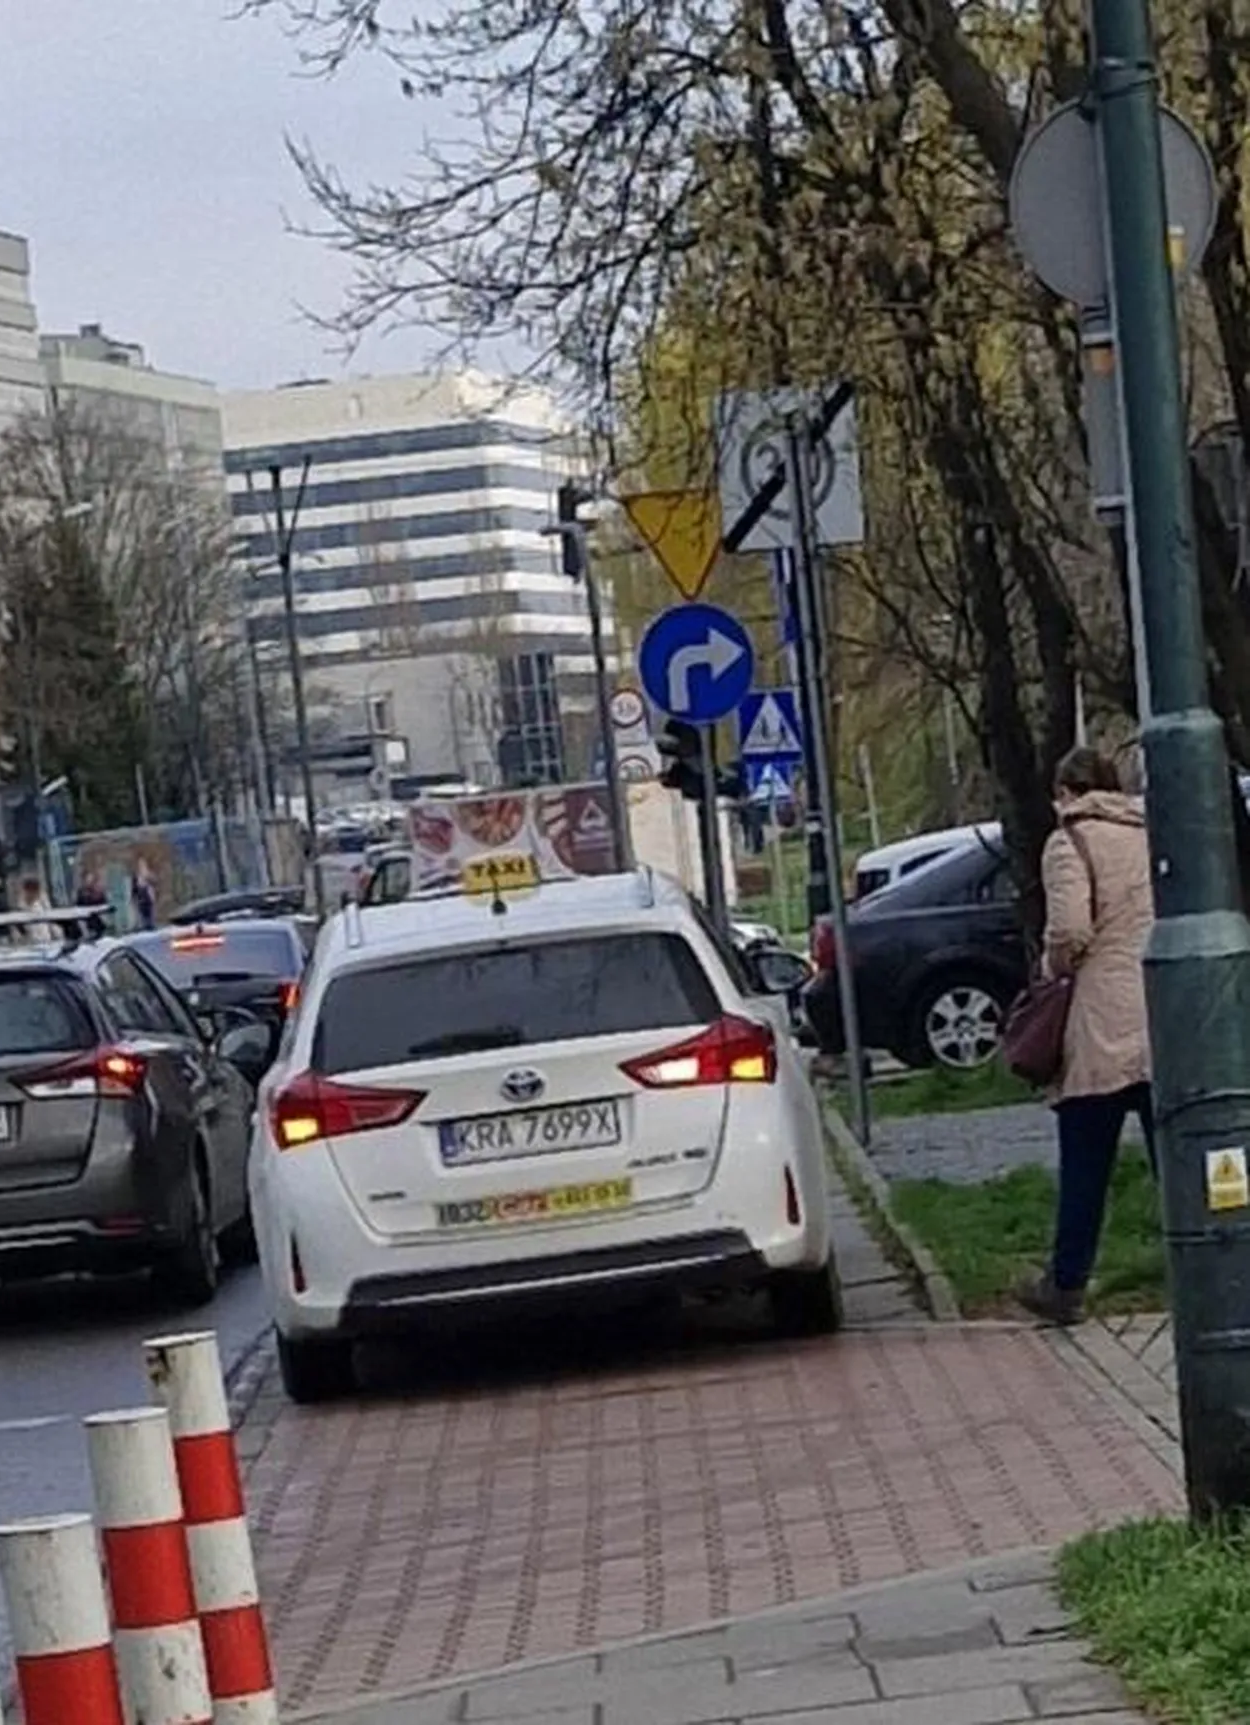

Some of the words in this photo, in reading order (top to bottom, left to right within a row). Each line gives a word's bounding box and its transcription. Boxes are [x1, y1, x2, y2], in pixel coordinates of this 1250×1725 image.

[468, 859, 526, 877] TAXI
[454, 1121, 515, 1151] KRA
[521, 1105, 613, 1146] 7699X
